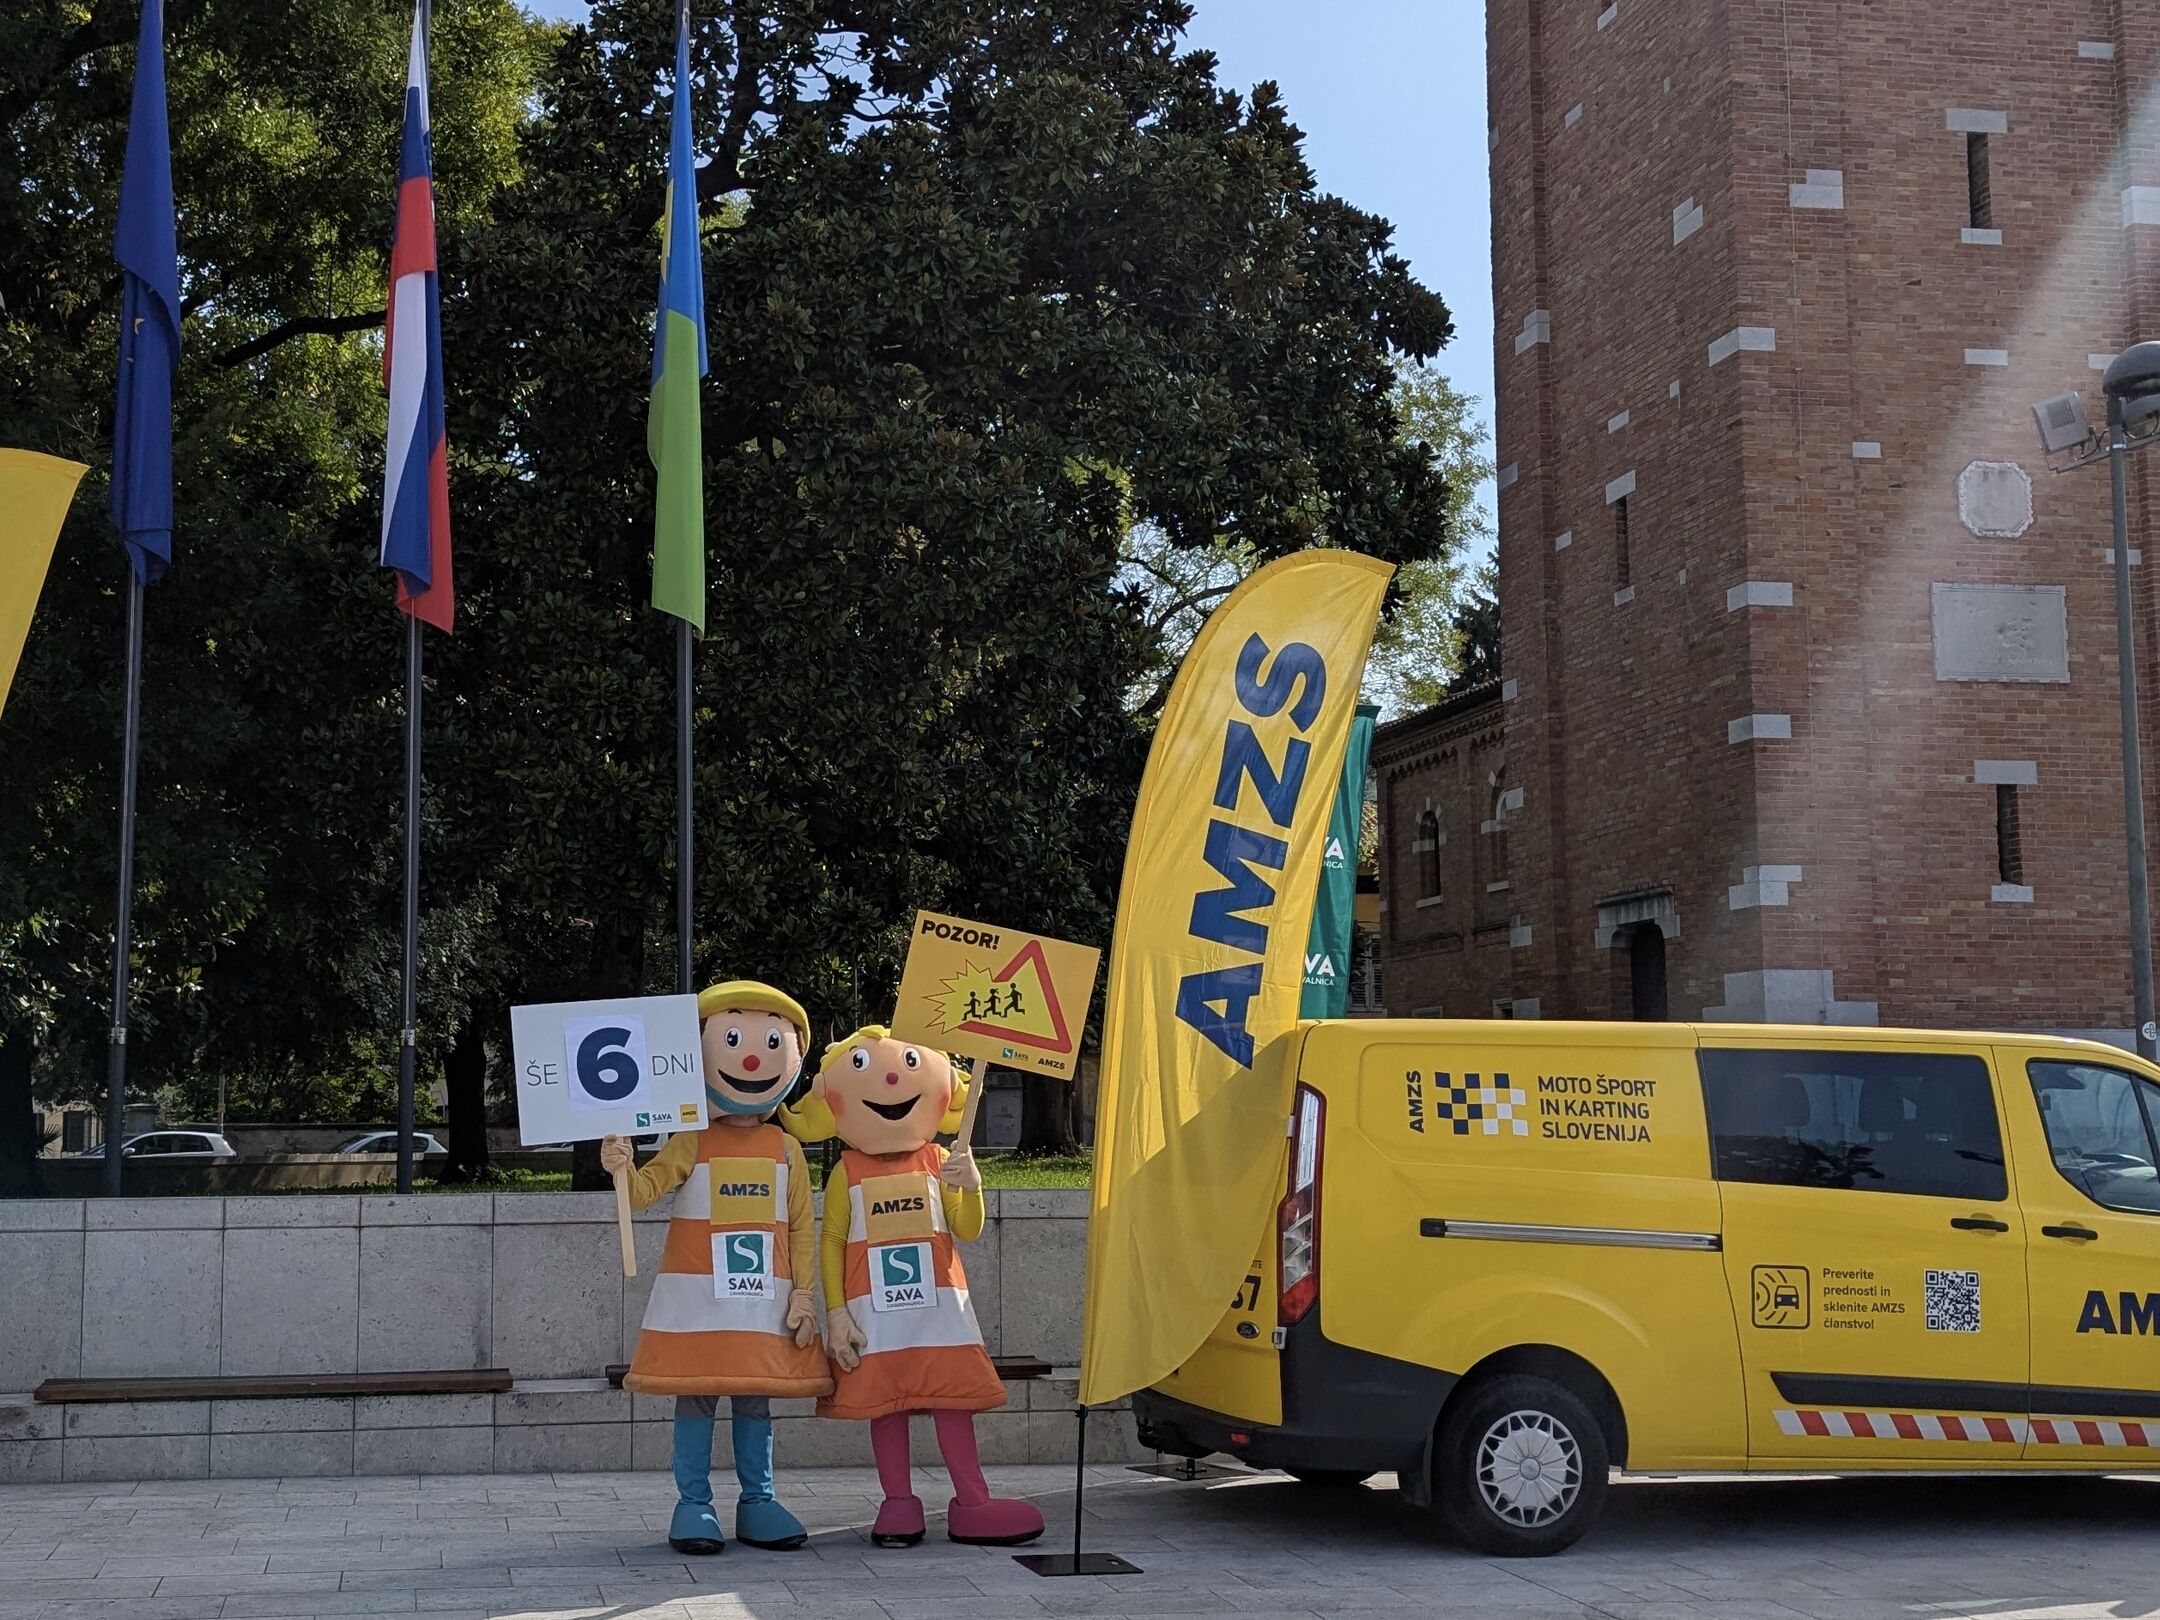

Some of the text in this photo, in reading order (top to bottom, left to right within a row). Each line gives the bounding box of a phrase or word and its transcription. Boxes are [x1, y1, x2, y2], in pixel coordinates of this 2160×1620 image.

[1175, 632, 1327, 1070] AMZS
[921, 919, 1000, 951] POZOR!
[526, 1027, 695, 1101] ŠE 6 DNI
[1038, 1058, 1066, 1070] AMZS
[1537, 1073, 1657, 1098] MOTO ŠPORT
[1405, 1070, 1425, 1134] AMZS
[1539, 1098, 1650, 1120] IN KARTING
[652, 1112, 673, 1121] SAVA
[1541, 1121, 1652, 1143] SLOVENIJA
[719, 1183, 770, 1197] AMZS
[871, 1197, 925, 1216] AMZS
[1822, 1268, 1874, 1280] Preverite
[728, 1277, 764, 1291] SAVA
[1823, 1285, 1891, 1298] prednosti in
[885, 1287, 924, 1303] SAVA
[1823, 1301, 1905, 1314] sklenite AMZS
[1823, 1317, 1874, 1330] članstvo!
